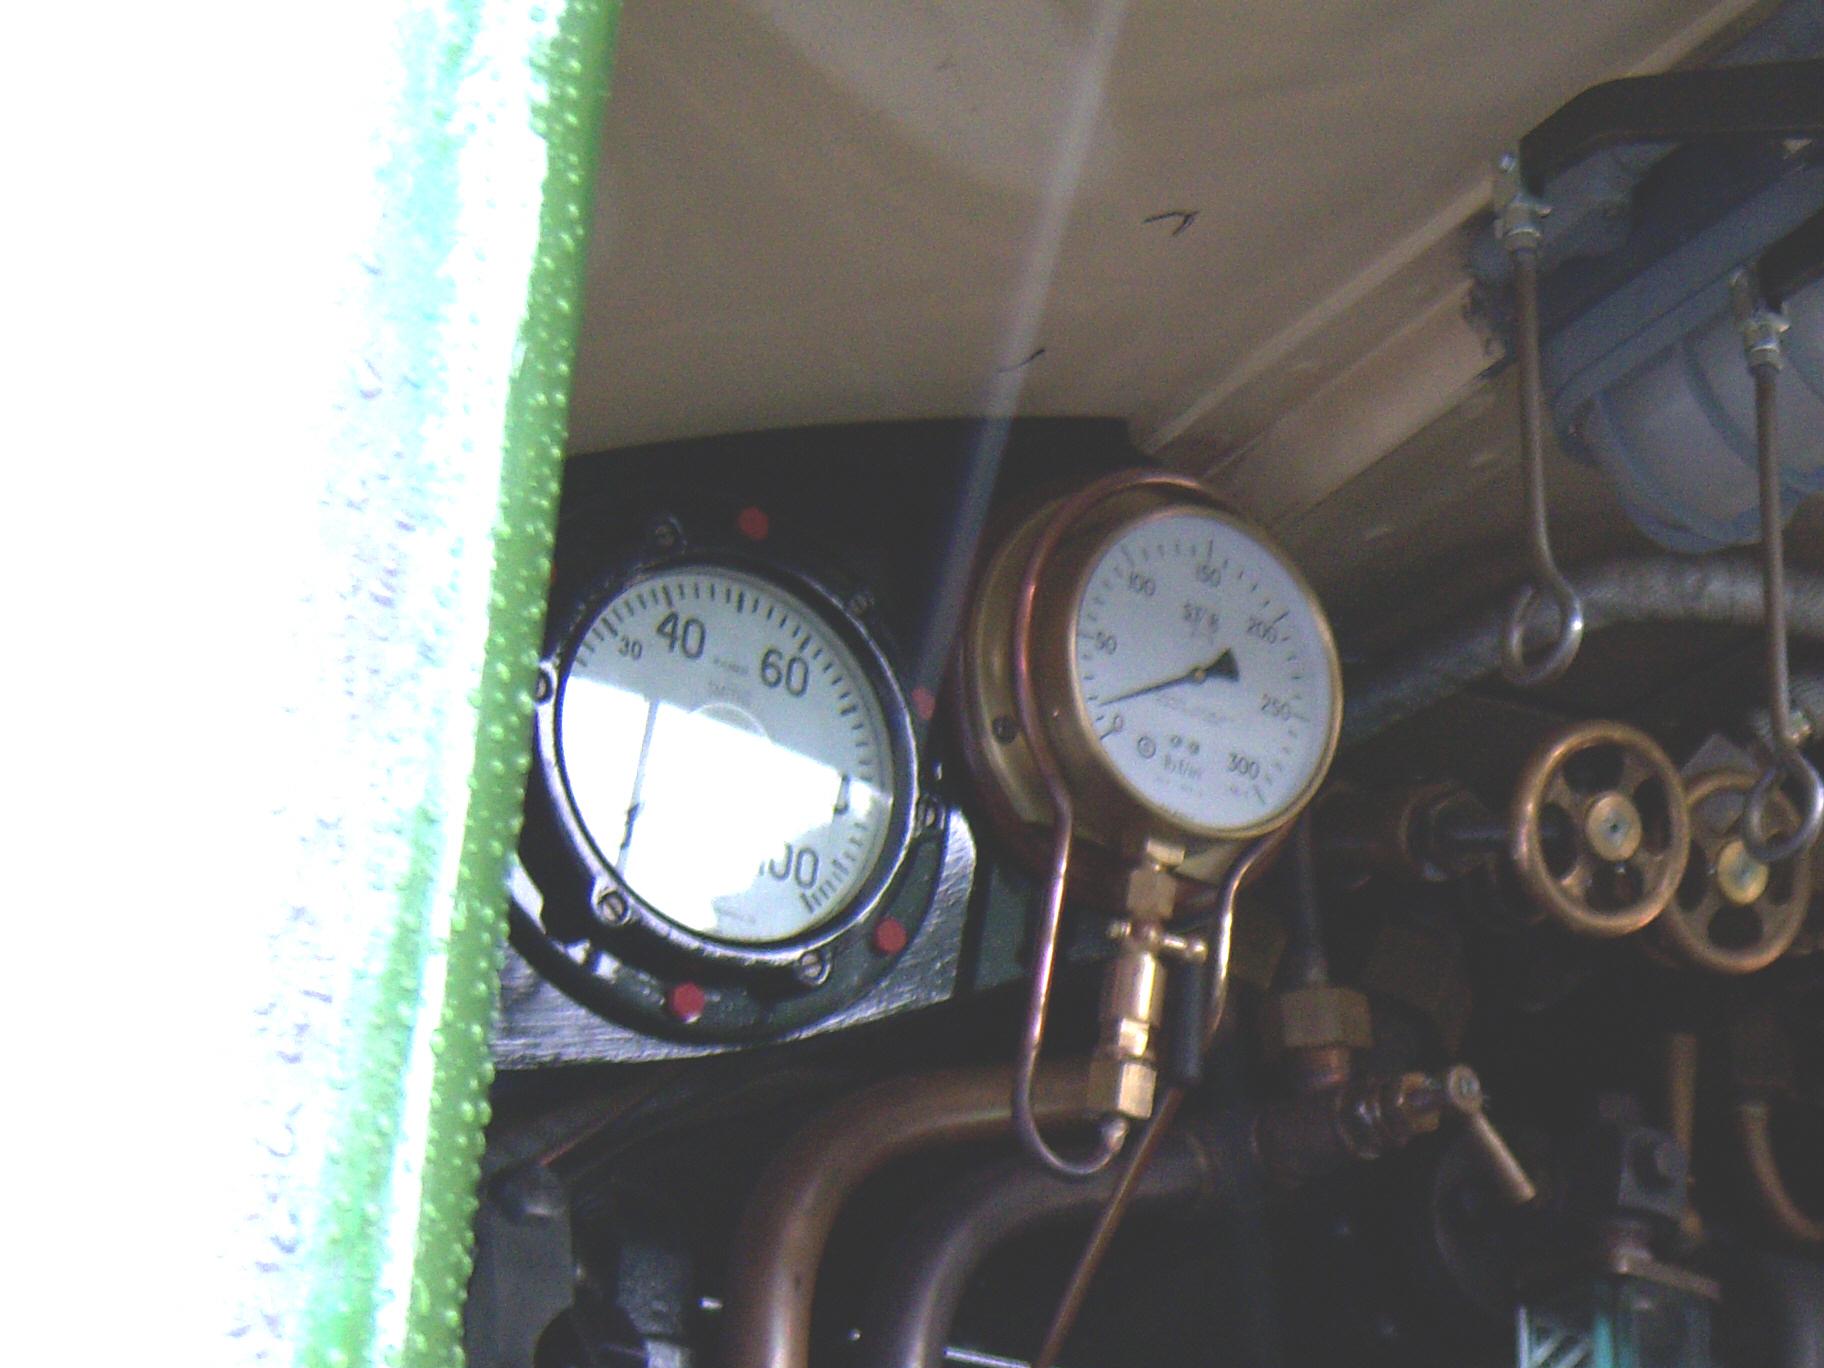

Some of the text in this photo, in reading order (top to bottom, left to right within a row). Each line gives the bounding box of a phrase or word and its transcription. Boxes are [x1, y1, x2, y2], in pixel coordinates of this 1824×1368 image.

[1127, 571, 1157, 598] 100
[656, 610, 707, 660] 40
[1095, 630, 1117, 655] 50
[1246, 614, 1278, 644] 200
[617, 635, 643, 662] 30
[760, 648, 810, 698] 60
[1260, 694, 1292, 722] 250
[1228, 751, 1260, 780] 300
